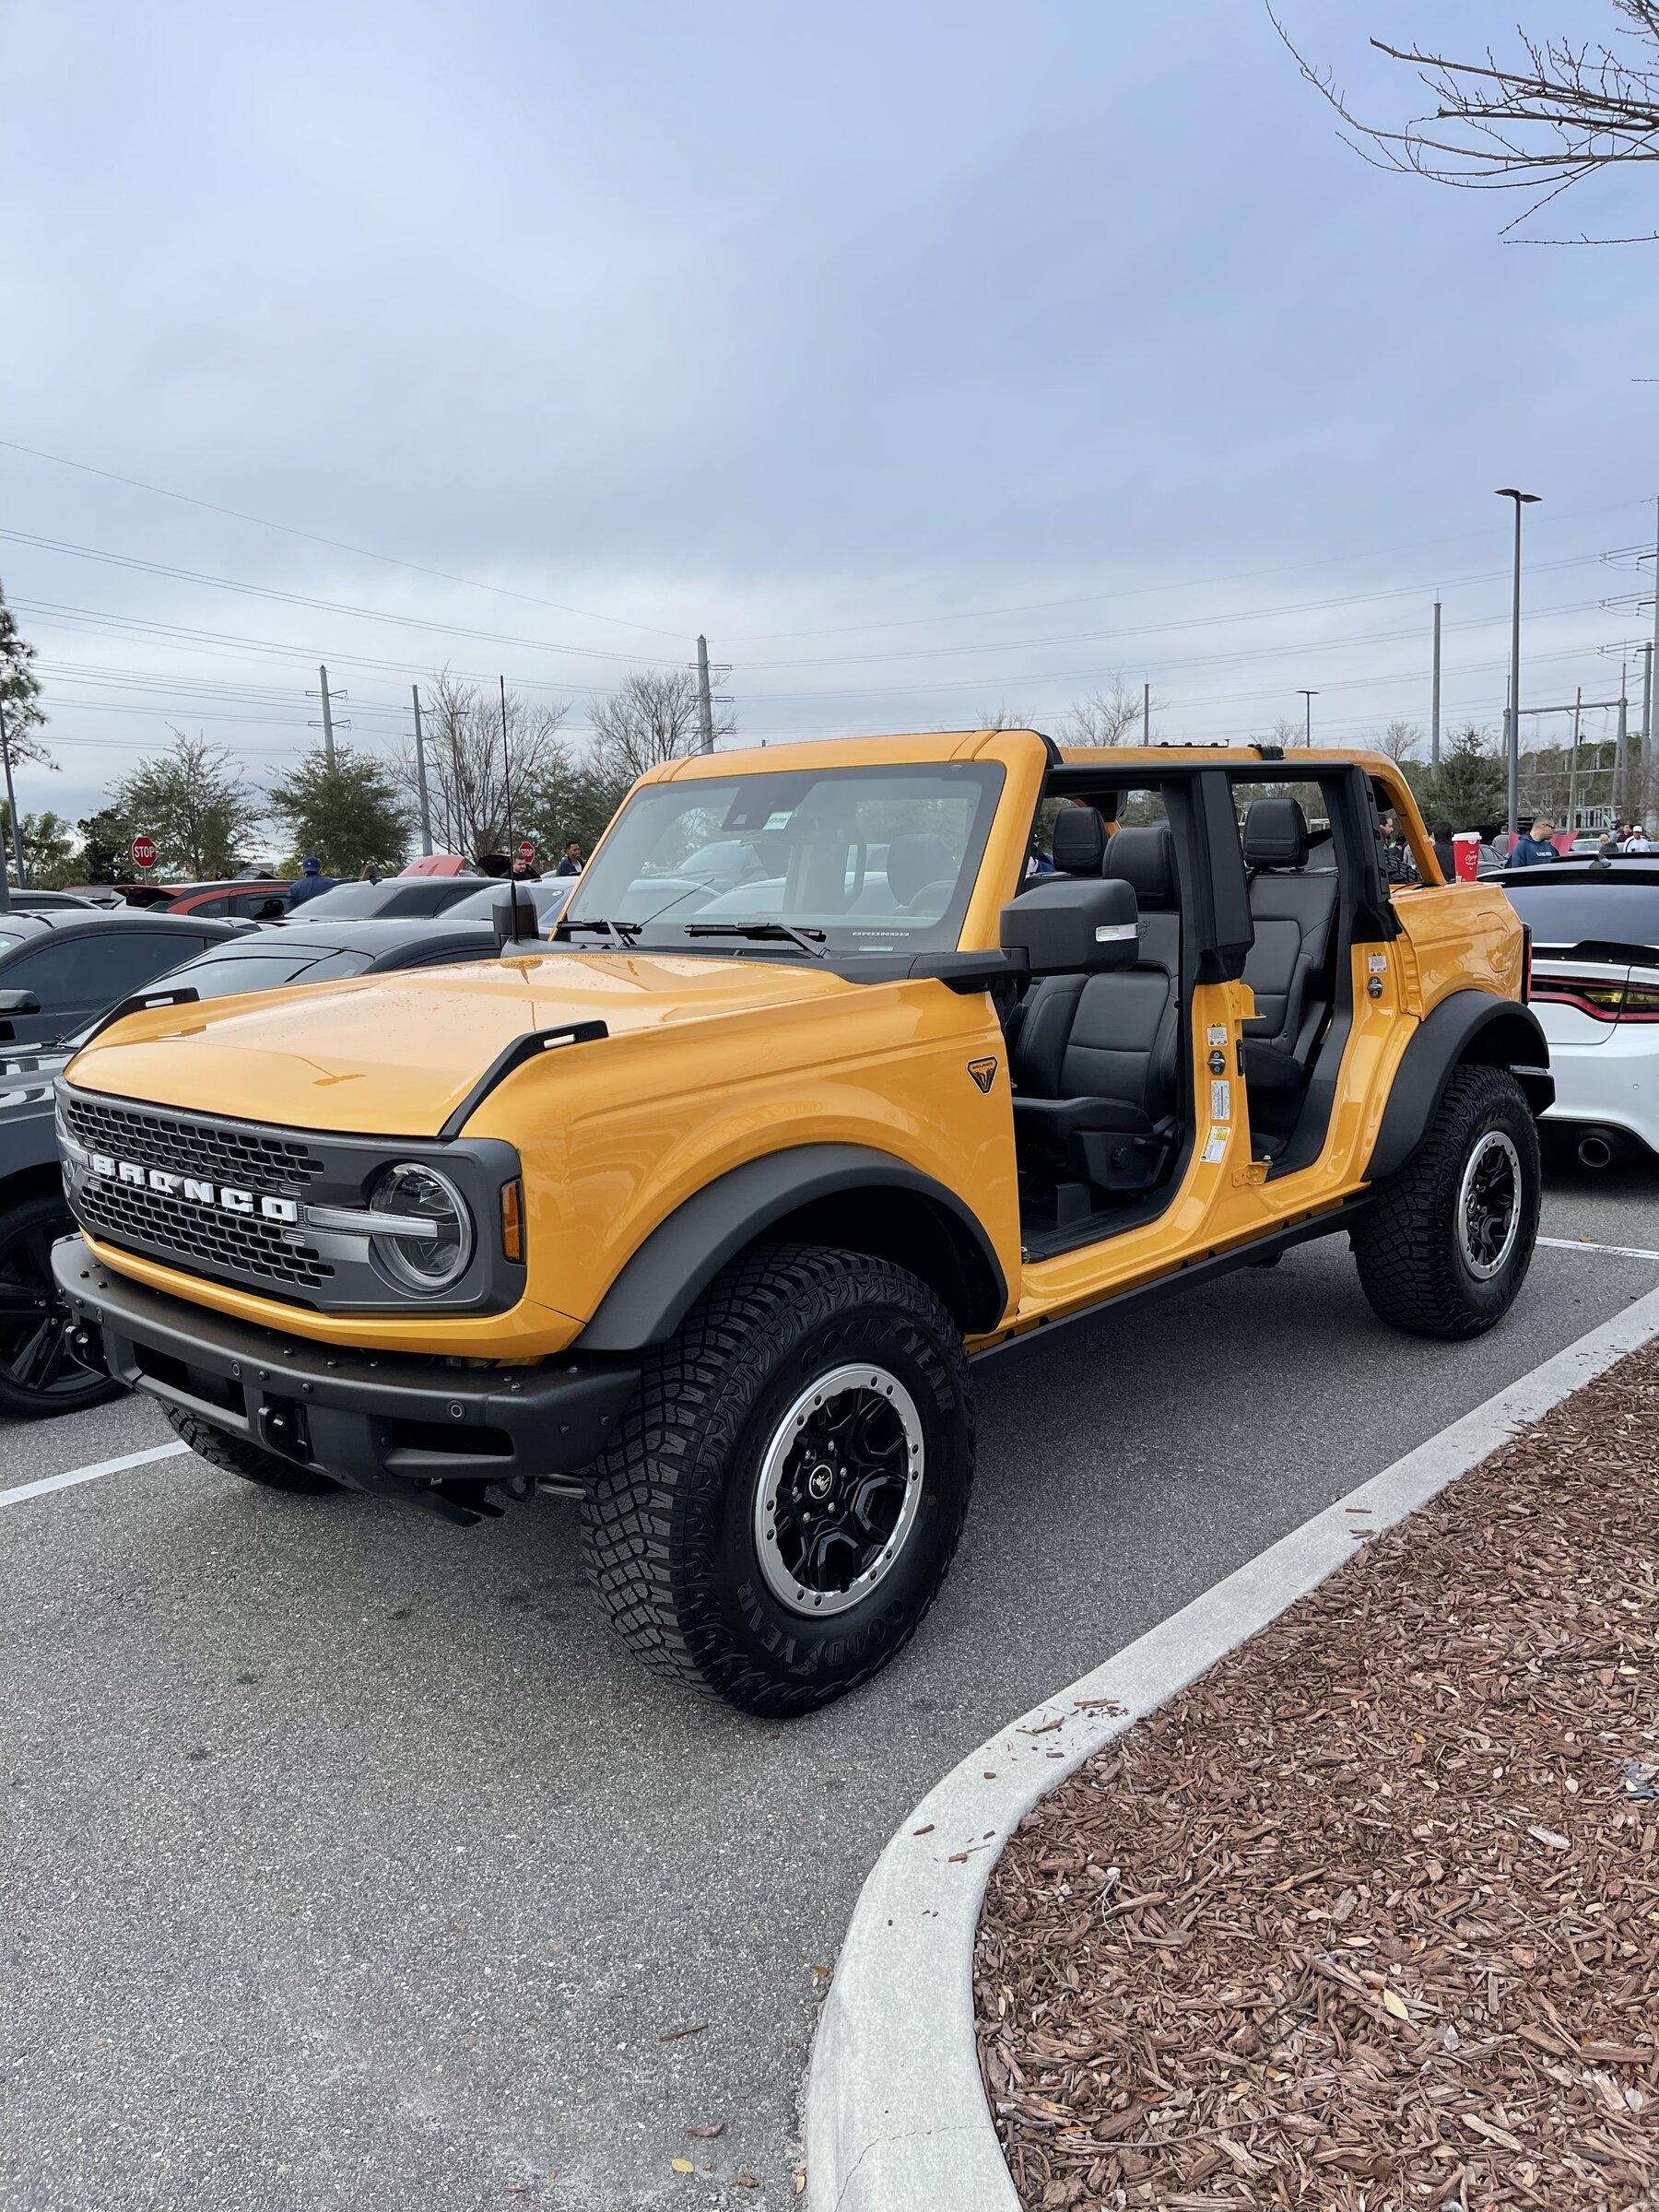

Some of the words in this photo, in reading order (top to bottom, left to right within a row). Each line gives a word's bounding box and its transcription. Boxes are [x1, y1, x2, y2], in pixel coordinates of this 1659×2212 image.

[134, 845, 155, 858] STOP
[520, 848, 533, 857] STOP
[93, 1153, 299, 1223] BRONCO
